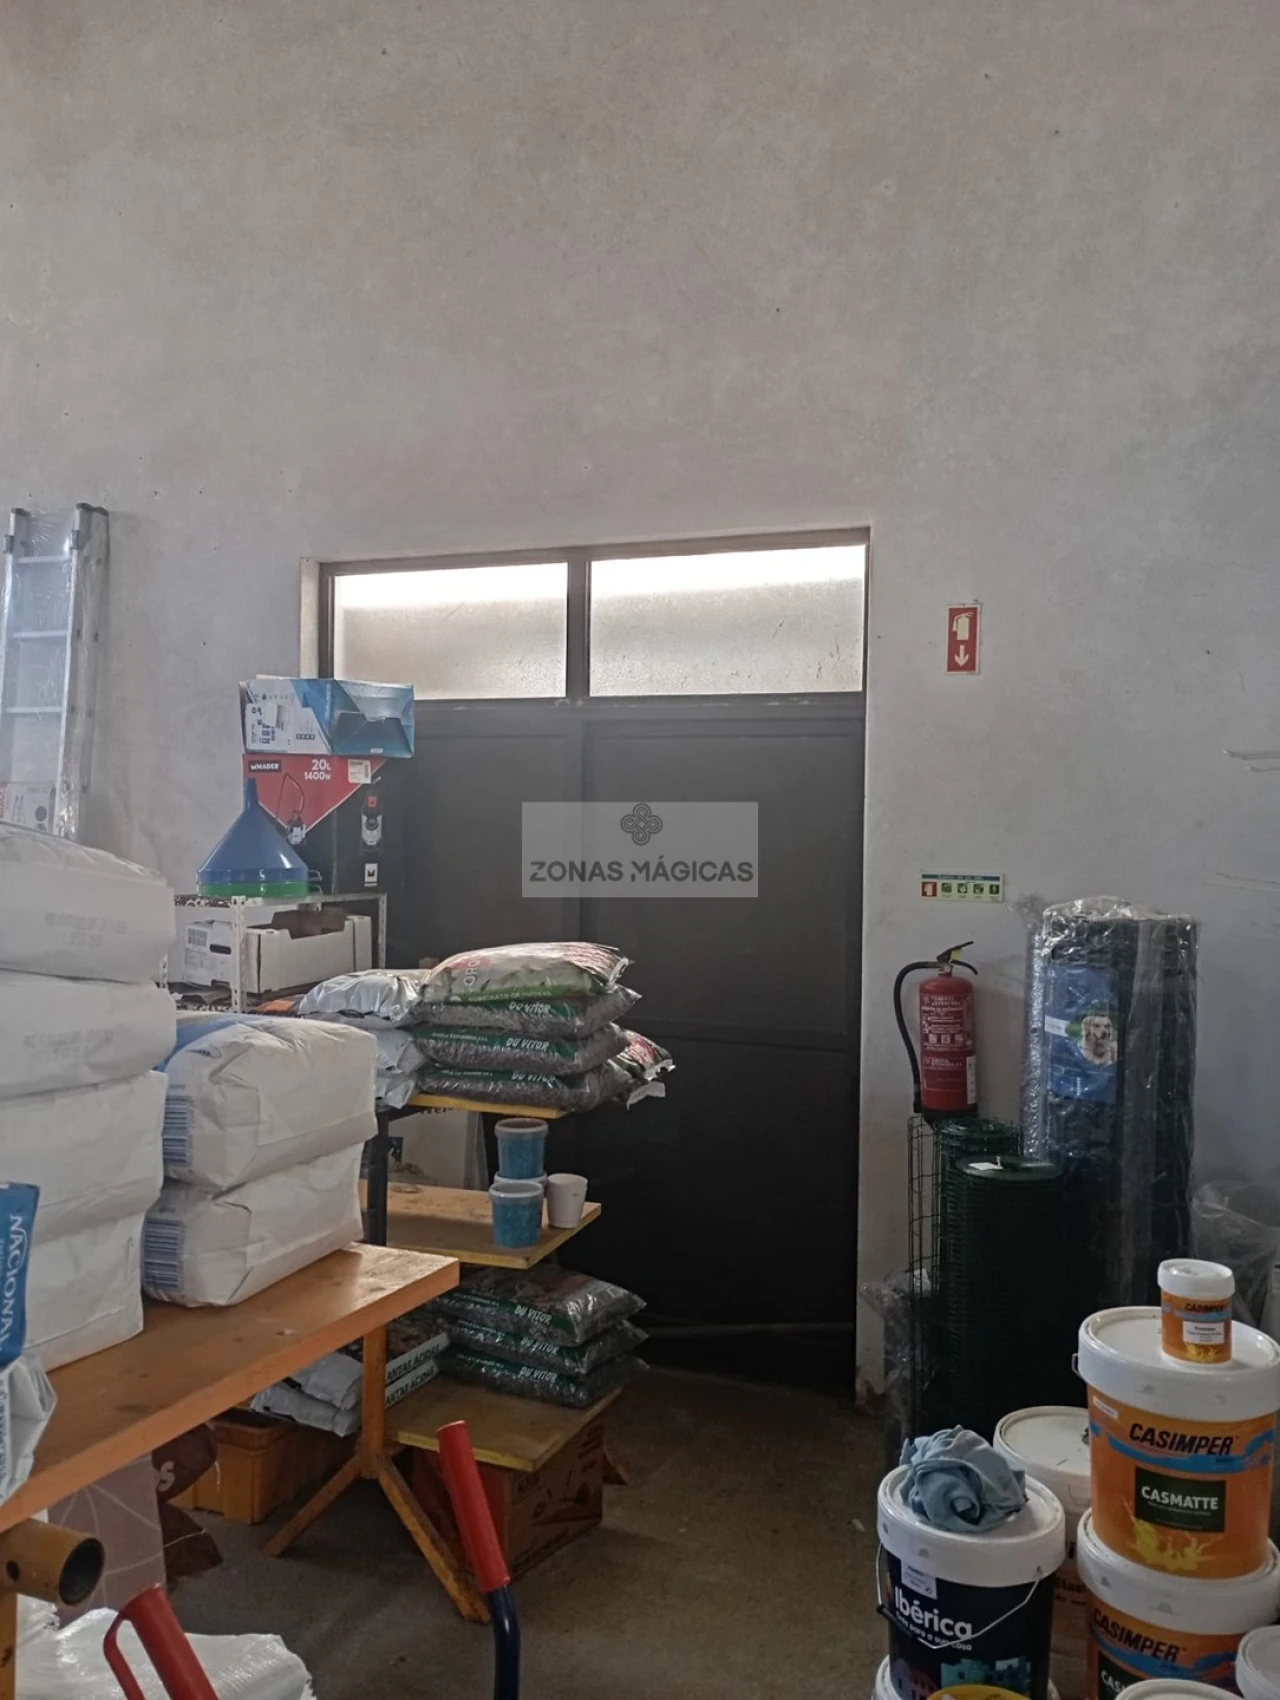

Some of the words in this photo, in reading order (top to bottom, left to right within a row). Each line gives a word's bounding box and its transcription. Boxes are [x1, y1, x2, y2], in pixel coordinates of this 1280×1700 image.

[312, 759, 331, 771] 20L
[1129, 1423, 1234, 1456] CASIMPER
[1141, 1486, 1219, 1510] CASMATTE
[894, 1585, 972, 1640] Ibérica
[1093, 1607, 1180, 1663] CASIMPER
